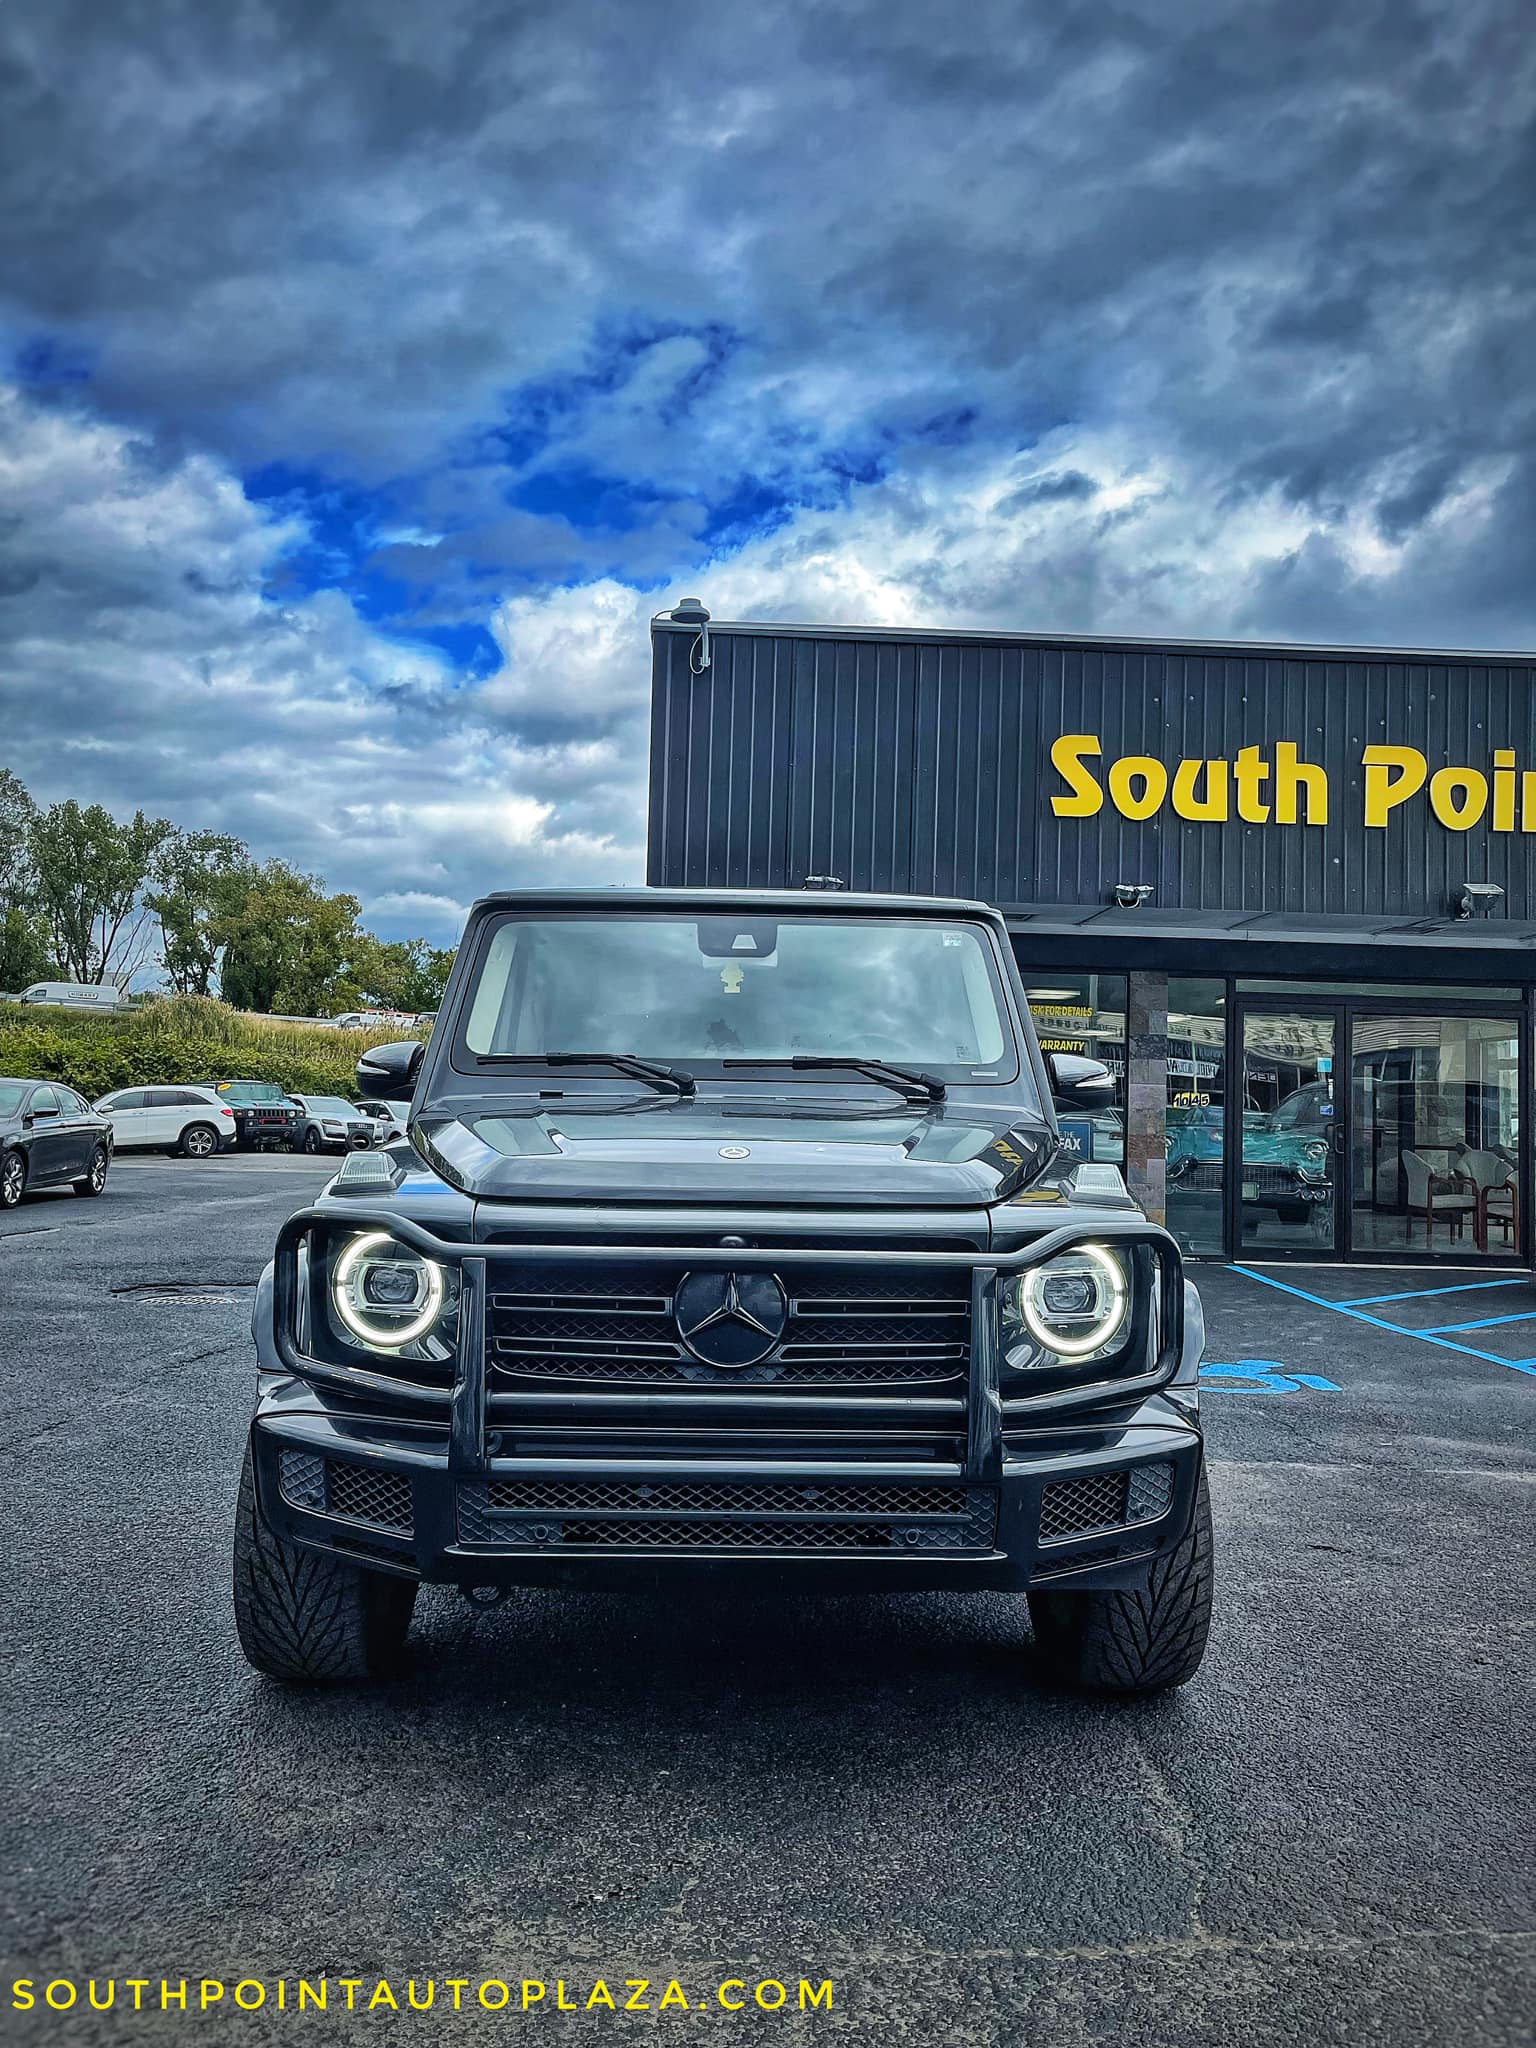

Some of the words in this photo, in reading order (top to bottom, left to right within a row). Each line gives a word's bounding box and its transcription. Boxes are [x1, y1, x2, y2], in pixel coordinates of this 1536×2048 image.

[1051, 734, 1328, 825] South
[1362, 744, 1536, 833] Poi
[1046, 1005, 1061, 1017] FOR
[1062, 1006, 1093, 1018] DETAILS
[1039, 1039, 1085, 1051] ARRANTY
[1173, 1092, 1210, 1107] 1045
